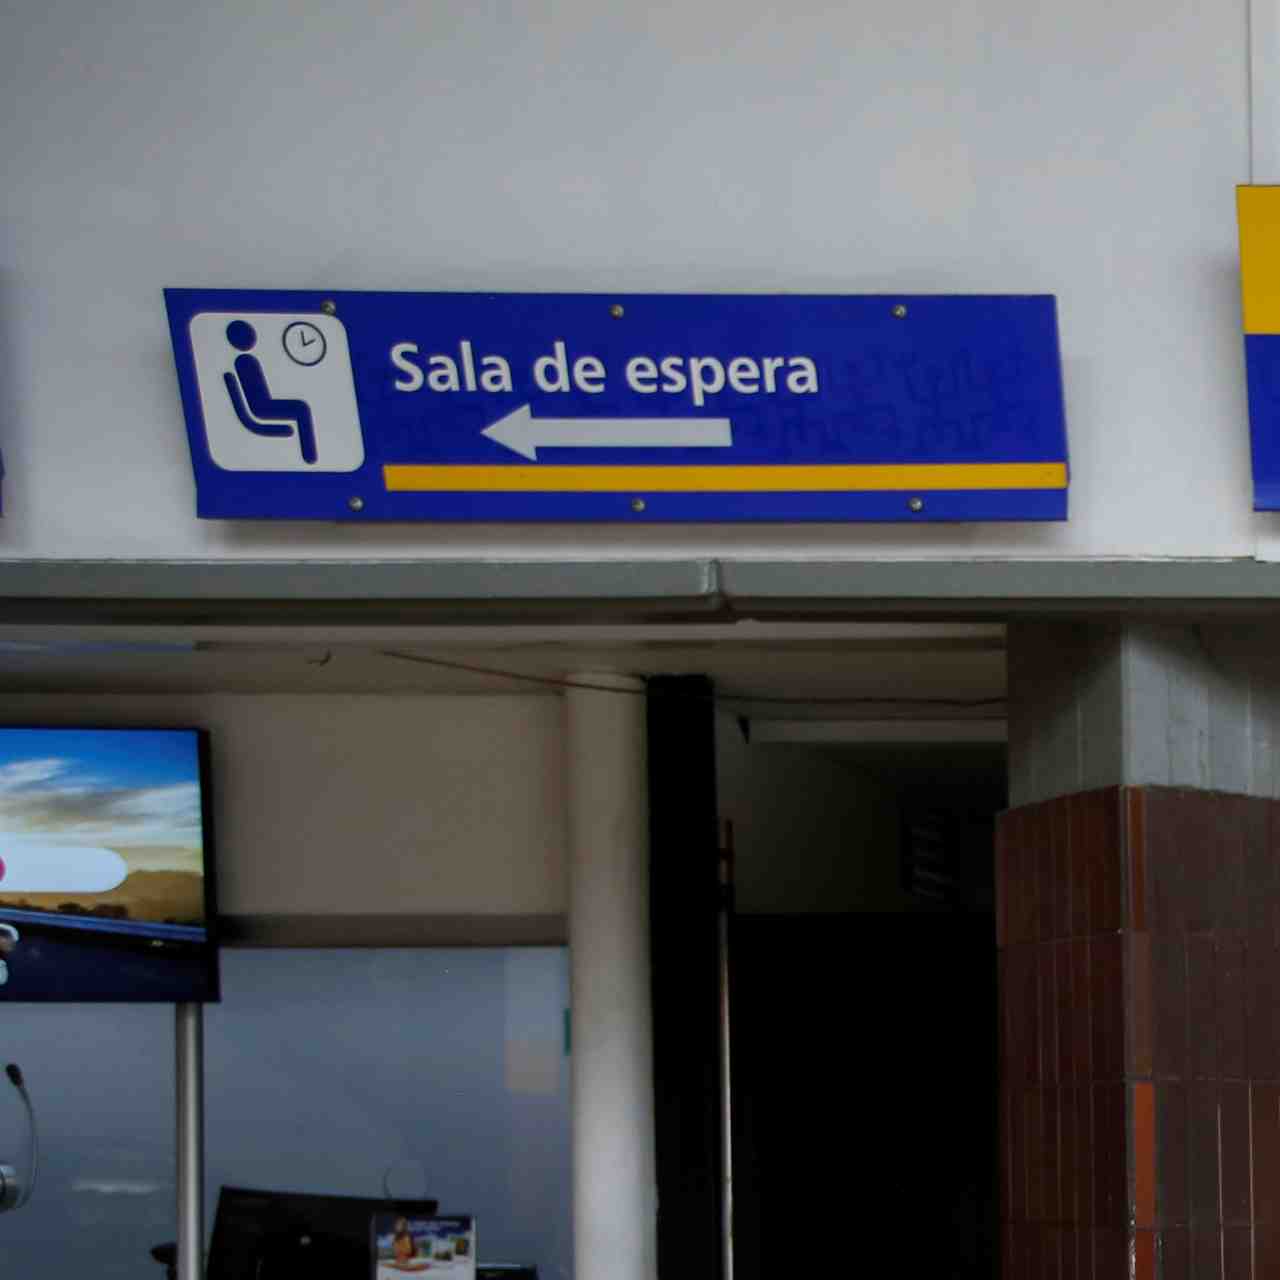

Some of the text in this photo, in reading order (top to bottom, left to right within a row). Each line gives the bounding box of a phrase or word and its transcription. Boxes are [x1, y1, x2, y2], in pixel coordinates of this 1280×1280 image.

[390, 340, 819, 406] Sala de espera
